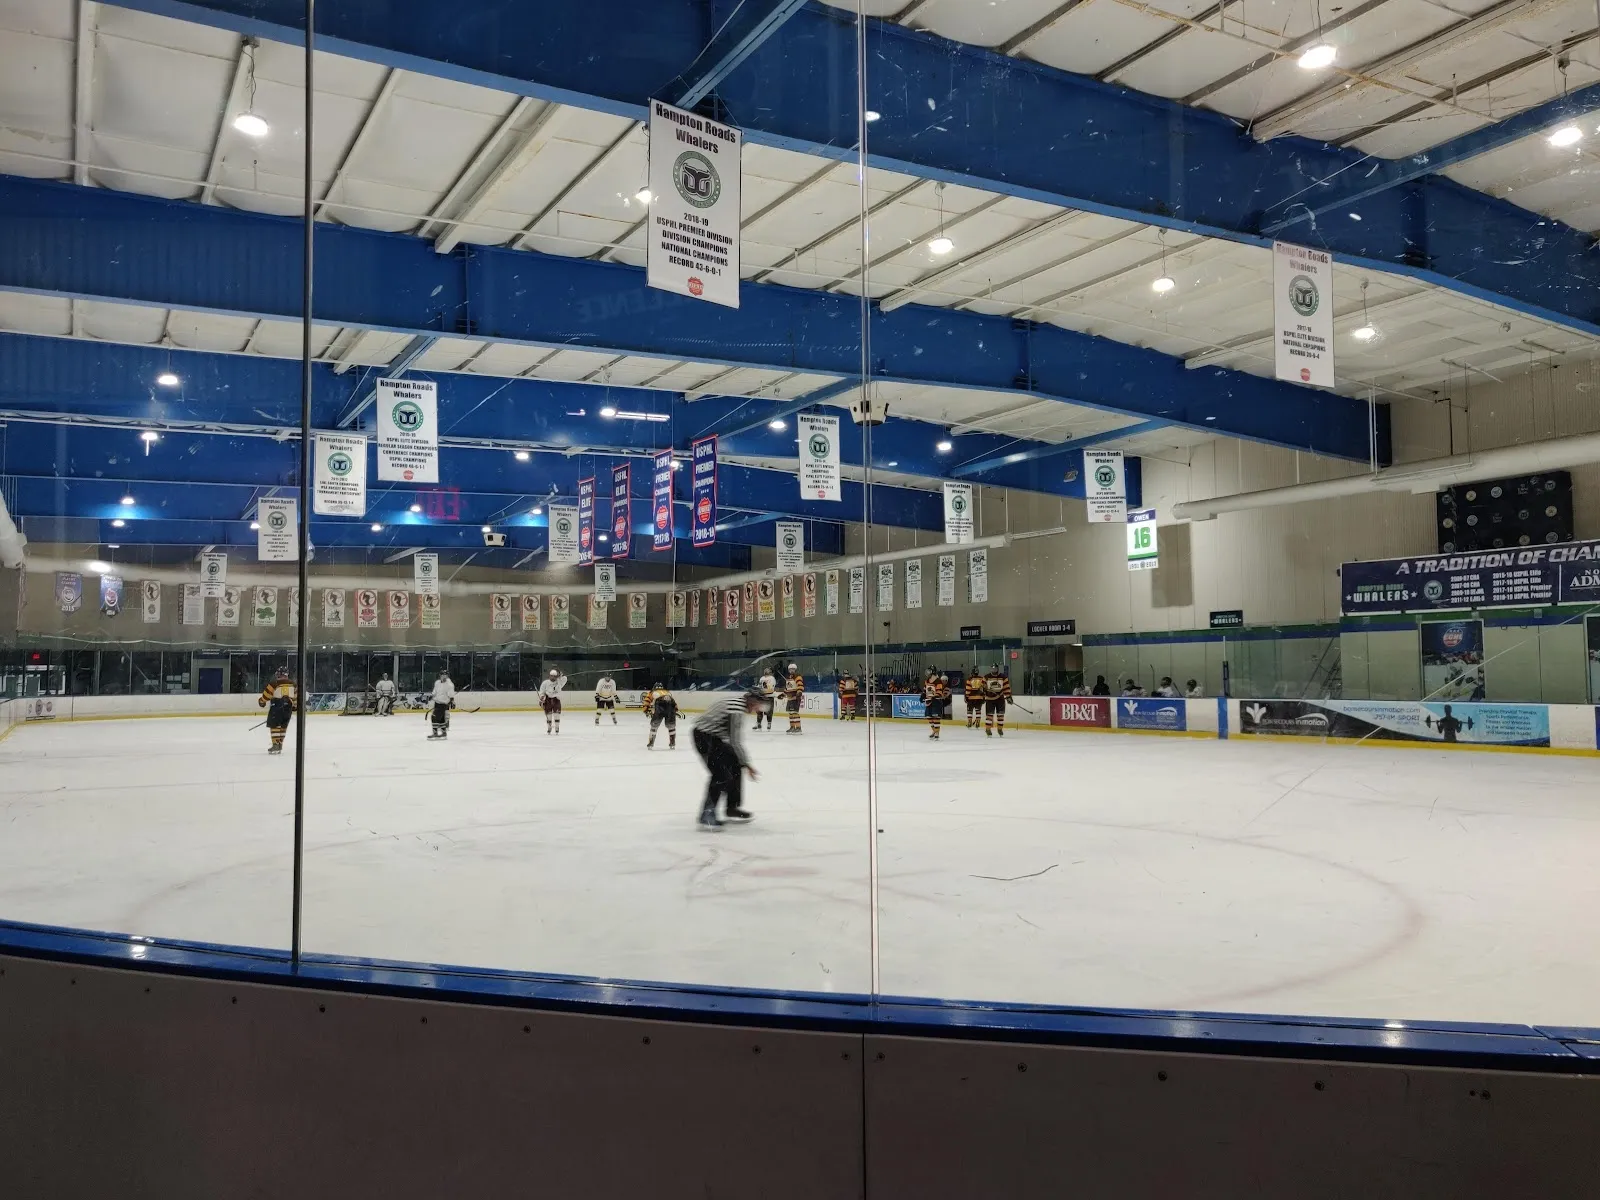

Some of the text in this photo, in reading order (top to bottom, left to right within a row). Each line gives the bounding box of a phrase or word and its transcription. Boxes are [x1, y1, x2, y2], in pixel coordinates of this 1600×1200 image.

[656, 103, 736, 143] Hampton Roads
[675, 128, 718, 154] Whalers
[683, 212, 709, 227] 2018-19
[656, 216, 733, 245] USPHL PREMIER DIVISION
[662, 229, 728, 255] DIVISION CHAMPIONS
[661, 241, 729, 267] NATIONAL CHAMPIONS
[669, 255, 694, 269] RECORD
[380, 380, 433, 391] Hampton Roads
[393, 390, 422, 400] Whalers
[695, 444, 714, 458] USPHL
[1133, 526, 1151, 549] 16
[1395, 561, 1411, 575] A
[1413, 552, 1516, 574] TRADITION
[1517, 549, 1547, 566] OF
[1353, 589, 1409, 603] WHALERS
[1061, 702, 1099, 721] BB&T
